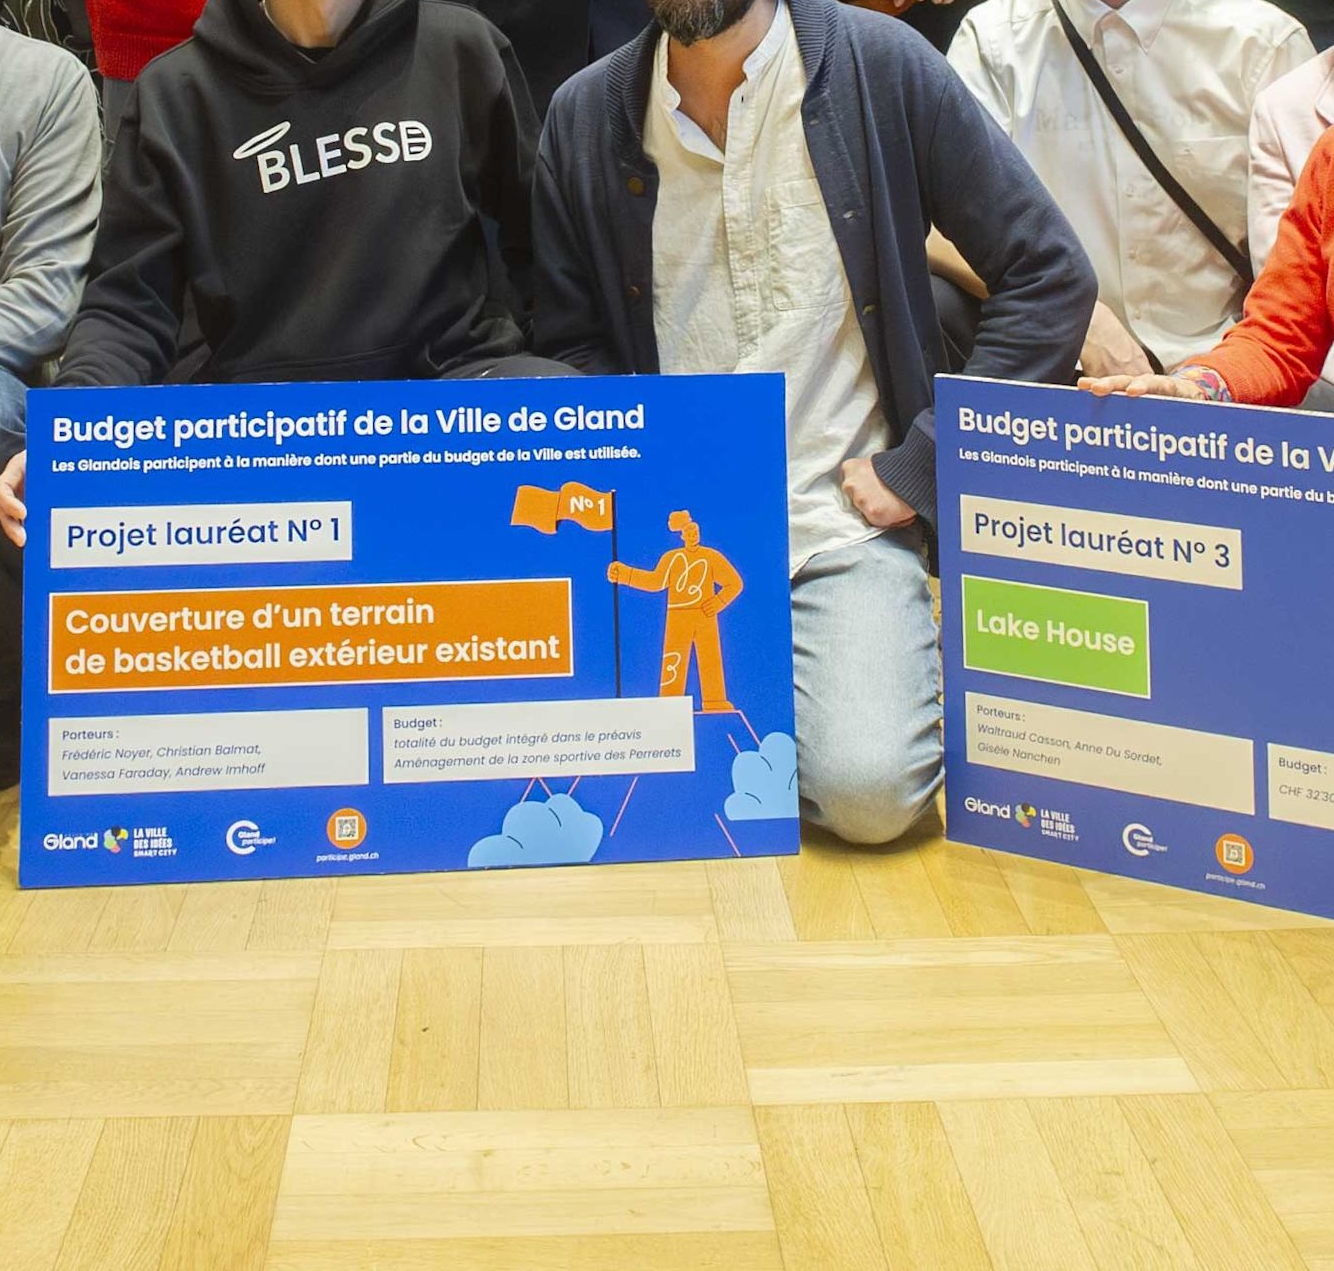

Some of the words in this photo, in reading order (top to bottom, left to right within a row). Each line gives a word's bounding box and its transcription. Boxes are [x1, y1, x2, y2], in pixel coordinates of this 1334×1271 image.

[53, 414, 166, 449] Budget
[173, 408, 347, 447] participatif
[353, 409, 393, 435] de
[400, 408, 428, 434] la
[434, 406, 501, 433] Ville
[507, 405, 547, 432] de
[553, 403, 644, 431] Gland
[958, 406, 1058, 445] Budget
[1064, 422, 1228, 461] participatif
[1233, 436, 1274, 465] de
[1280, 440, 1310, 470] la
[51, 459, 75, 472] Les
[77, 456, 141, 471] Glandois
[142, 455, 222, 473] participent
[223, 454, 234, 468] à
[235, 454, 250, 468] la
[251, 452, 312, 467] manière
[313, 452, 347, 466] dont
[348, 454, 377, 465] une
[378, 450, 421, 468] partie
[421, 450, 442, 463] du
[443, 449, 495, 466] budget
[495, 448, 515, 462] de
[516, 448, 531, 461] la
[532, 446, 563, 460] Ville
[563, 447, 586, 460] est
[588, 444, 641, 459] utilisée.
[958, 447, 979, 461] Les
[980, 450, 1036, 468] Glandois
[1037, 458, 1109, 477] participent
[1110, 464, 1121, 478] à
[1122, 465, 1136, 480] la
[1137, 470, 1195, 487] manière
[1195, 475, 1229, 491] dont
[1230, 481, 1258, 494] une
[1259, 484, 1303, 500] partie
[1303, 488, 1324, 502] du
[597, 497, 605, 515] 1
[67, 521, 157, 555] Projet
[166, 517, 278, 545] lauréat
[329, 516, 339, 541] 1
[974, 511, 1053, 548] Projet
[1060, 522, 1164, 560] lauréat
[1214, 543, 1230, 568] 3
[65, 606, 245, 634] Couverture
[251, 602, 322, 629] d’un
[329, 596, 434, 626] terrain
[976, 608, 1040, 640] Lake
[1046, 619, 1135, 655] House
[64, 647, 106, 674] de
[113, 642, 280, 673] basketball
[288, 637, 428, 668] extérieur
[434, 634, 560, 662] existant
[61, 747, 111, 761] Frédéric
[155, 744, 212, 758] Christian
[393, 736, 436, 749] totalité
[438, 736, 456, 747] du
[458, 734, 502, 749] budget
[505, 732, 548, 747] intégré
[550, 731, 581, 743] dans
[583, 730, 595, 742] le
[596, 728, 642, 744] préavis
[976, 722, 1027, 741] Waltraud
[1073, 740, 1103, 754] Anne
[1104, 745, 1121, 758] Du
[976, 741, 1010, 756] Gisèle
[1011, 747, 1061, 766] Nanchen
[61, 769, 115, 780] Vanessa
[174, 764, 223, 777] Andrew
[224, 761, 266, 775] Imhoff
[393, 755, 485, 771] Aménagement
[487, 754, 504, 765] de
[506, 753, 519, 764] la
[521, 753, 551, 764] zone
[552, 750, 601, 766] sportive
[603, 749, 626, 761] des
[628, 747, 682, 759] Perrerets
[1278, 783, 1303, 797] CHF
[42, 831, 98, 850] Gland
